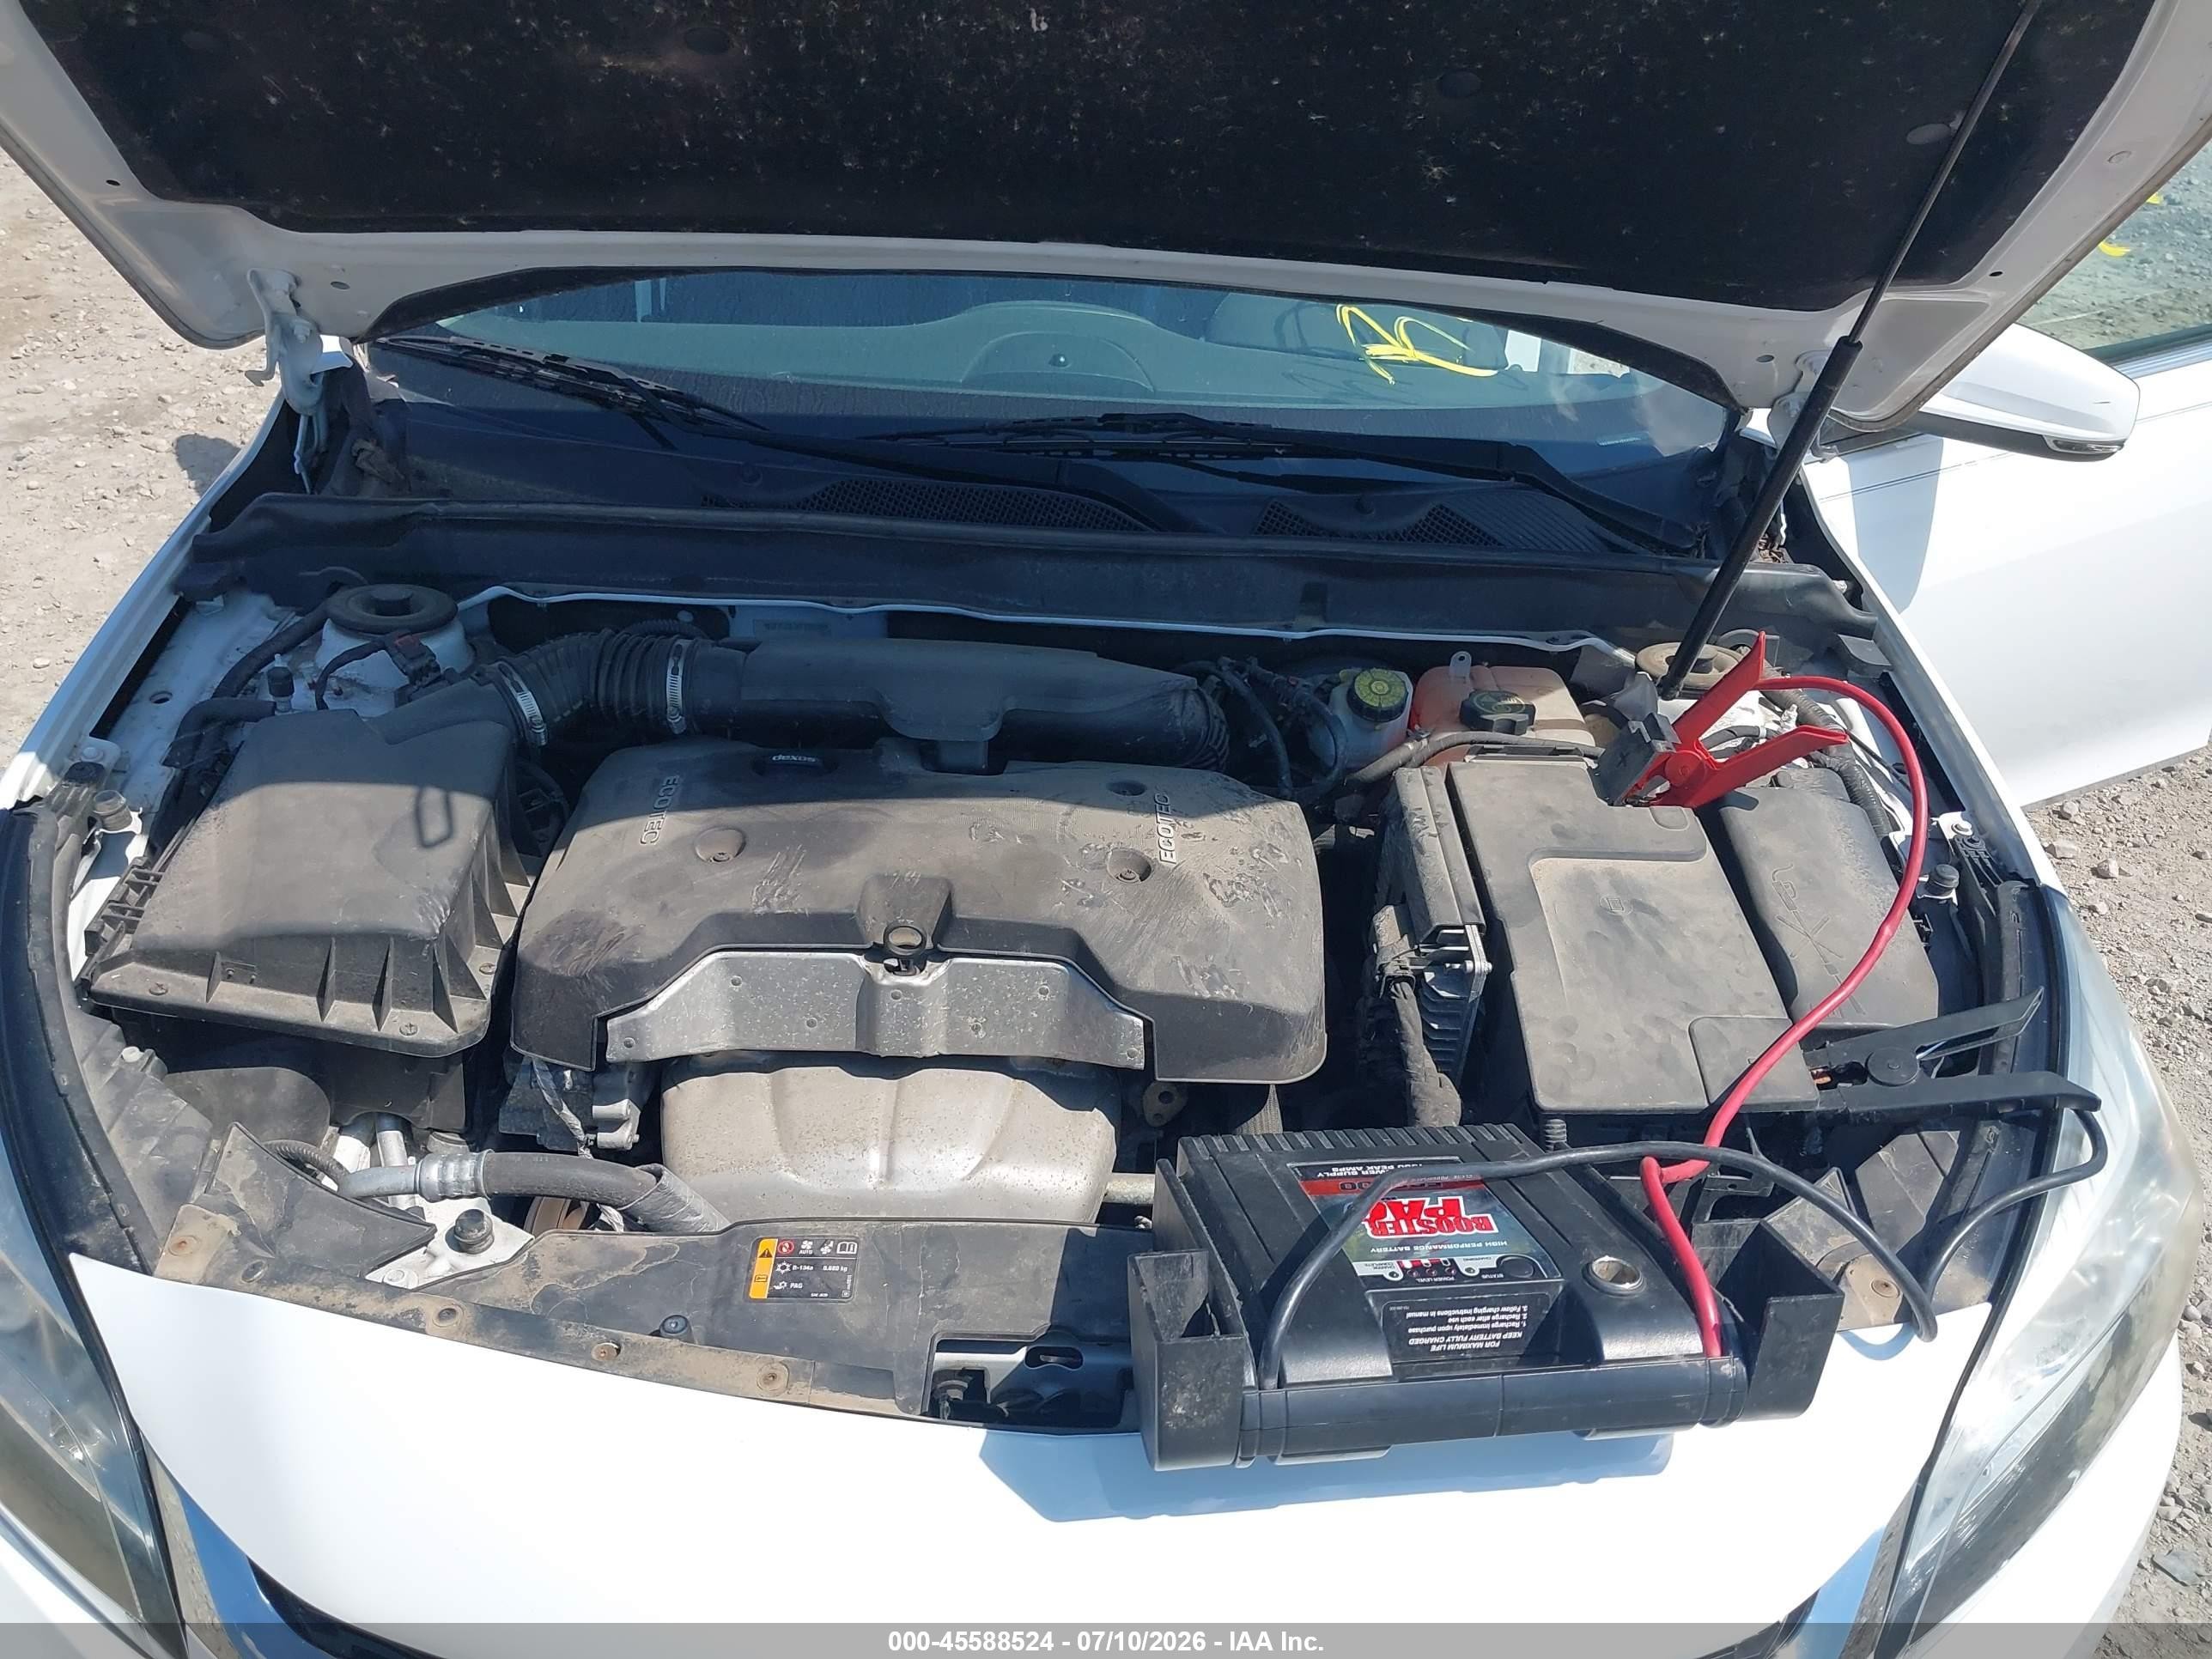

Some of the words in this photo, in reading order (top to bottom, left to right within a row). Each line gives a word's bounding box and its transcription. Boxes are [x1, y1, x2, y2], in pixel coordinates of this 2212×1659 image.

[772, 754, 817, 763] dexos
[640, 775, 679, 845] ECOTEC
[1153, 793, 1176, 865] ECOTEC
[1367, 1215, 1497, 1237] BOOSTER
[1413, 1242, 1483, 1251] PERFORMANCE
[1474, 1306, 1500, 1315] charging
[1407, 1325, 1437, 1334] purchase
[1454, 1322, 1491, 1331] immediately
[1408, 1336, 1445, 1346] CHARGED
[1445, 1334, 1468, 1343] FULLY
[1468, 1332, 1502, 1341] BATTERY
[1447, 1341, 1484, 1351] MAXIMUM
